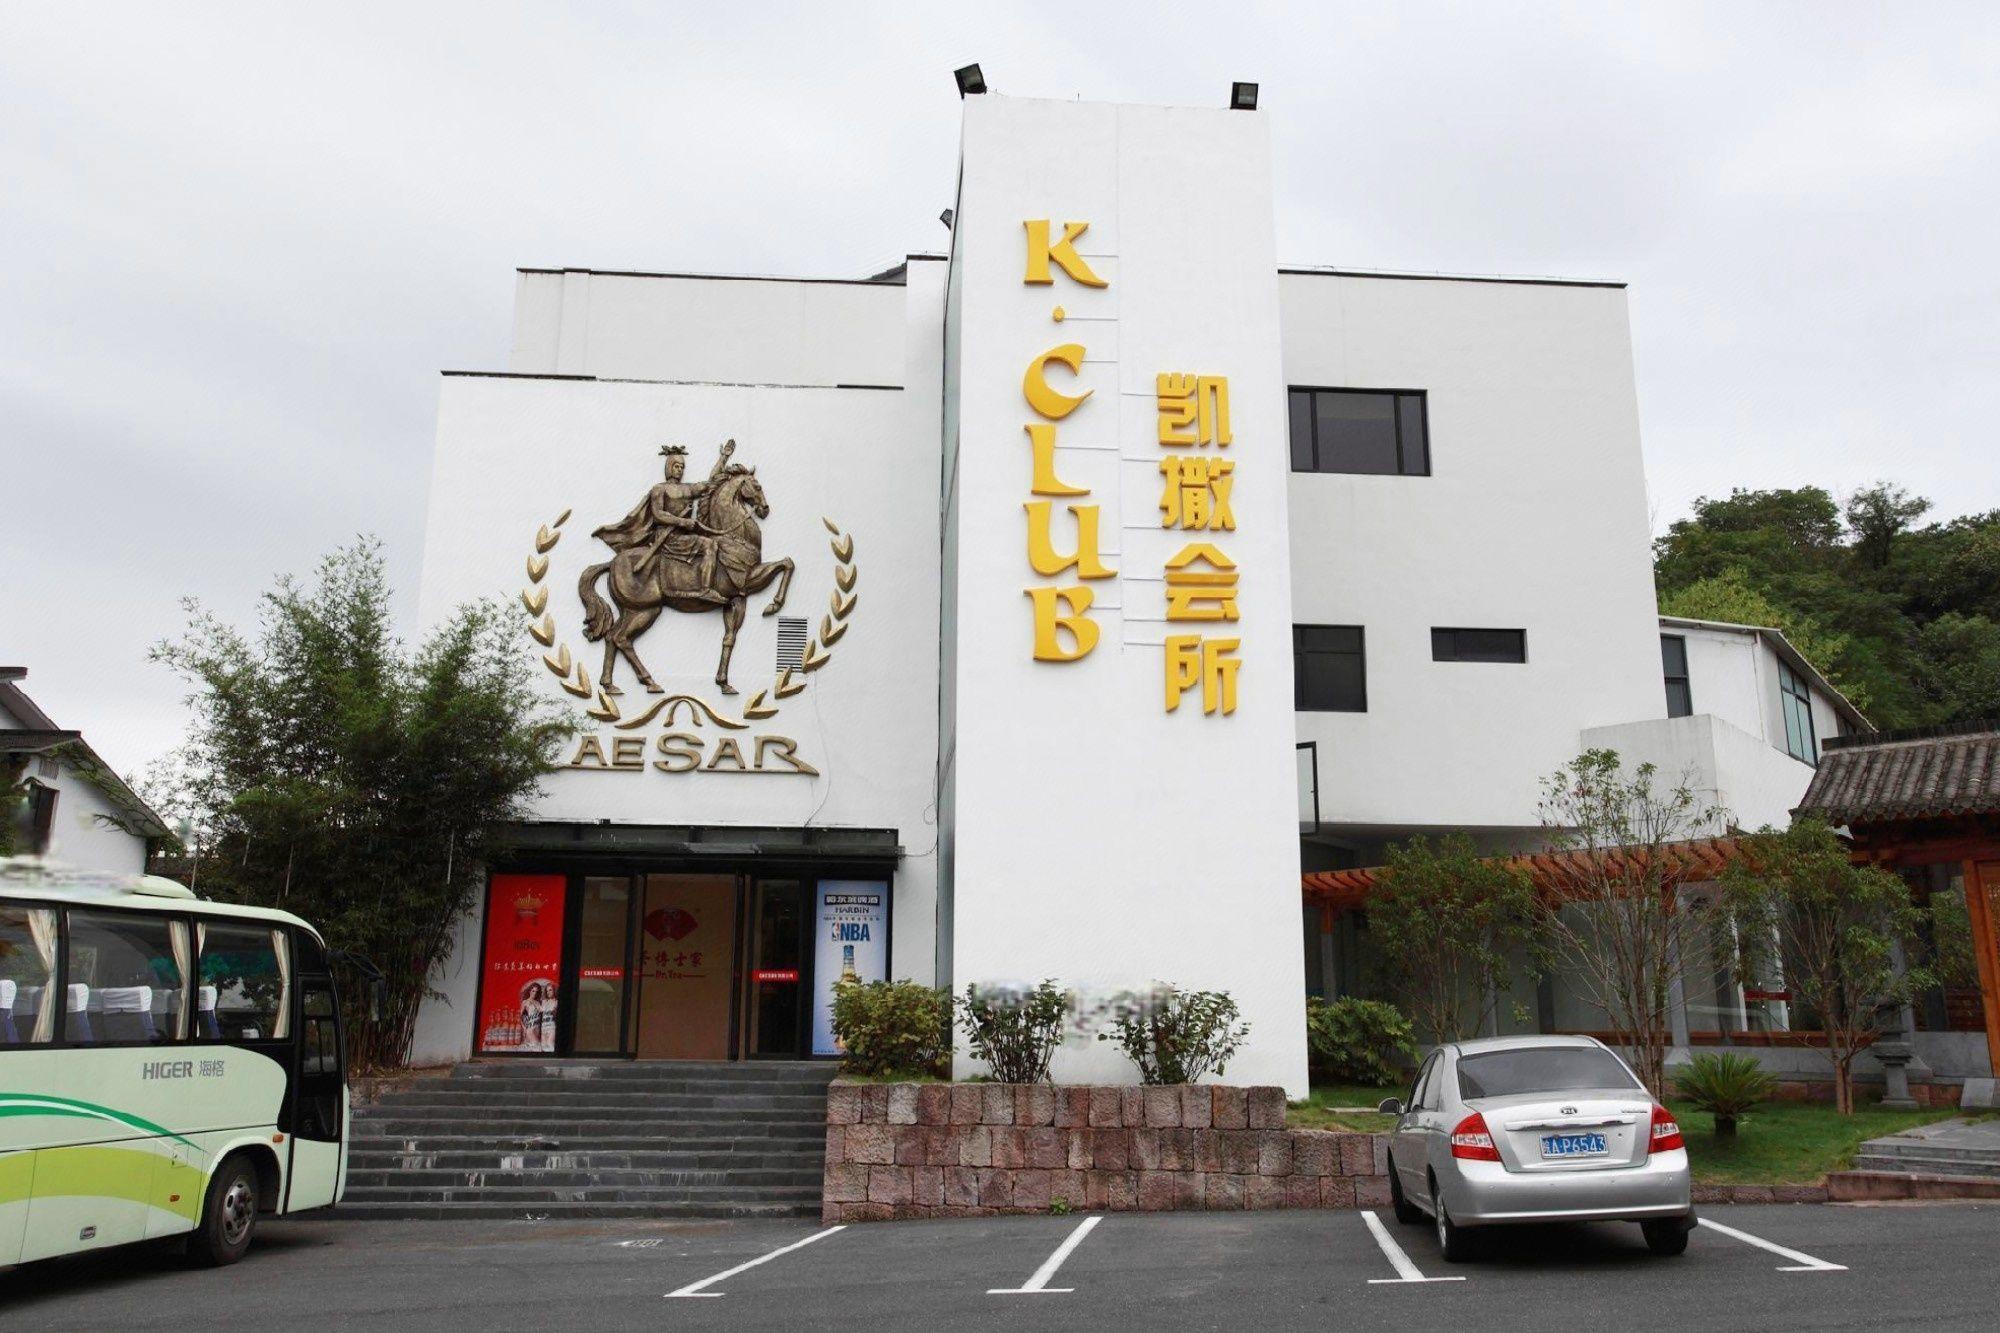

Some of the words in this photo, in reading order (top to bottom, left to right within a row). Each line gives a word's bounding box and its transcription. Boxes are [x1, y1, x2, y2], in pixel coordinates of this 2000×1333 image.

[1156, 372, 1241, 716] 凯撒会所
[840, 923, 871, 941] NBA
[142, 1061, 193, 1080] HIGER
[200, 1060, 224, 1077] 海格
